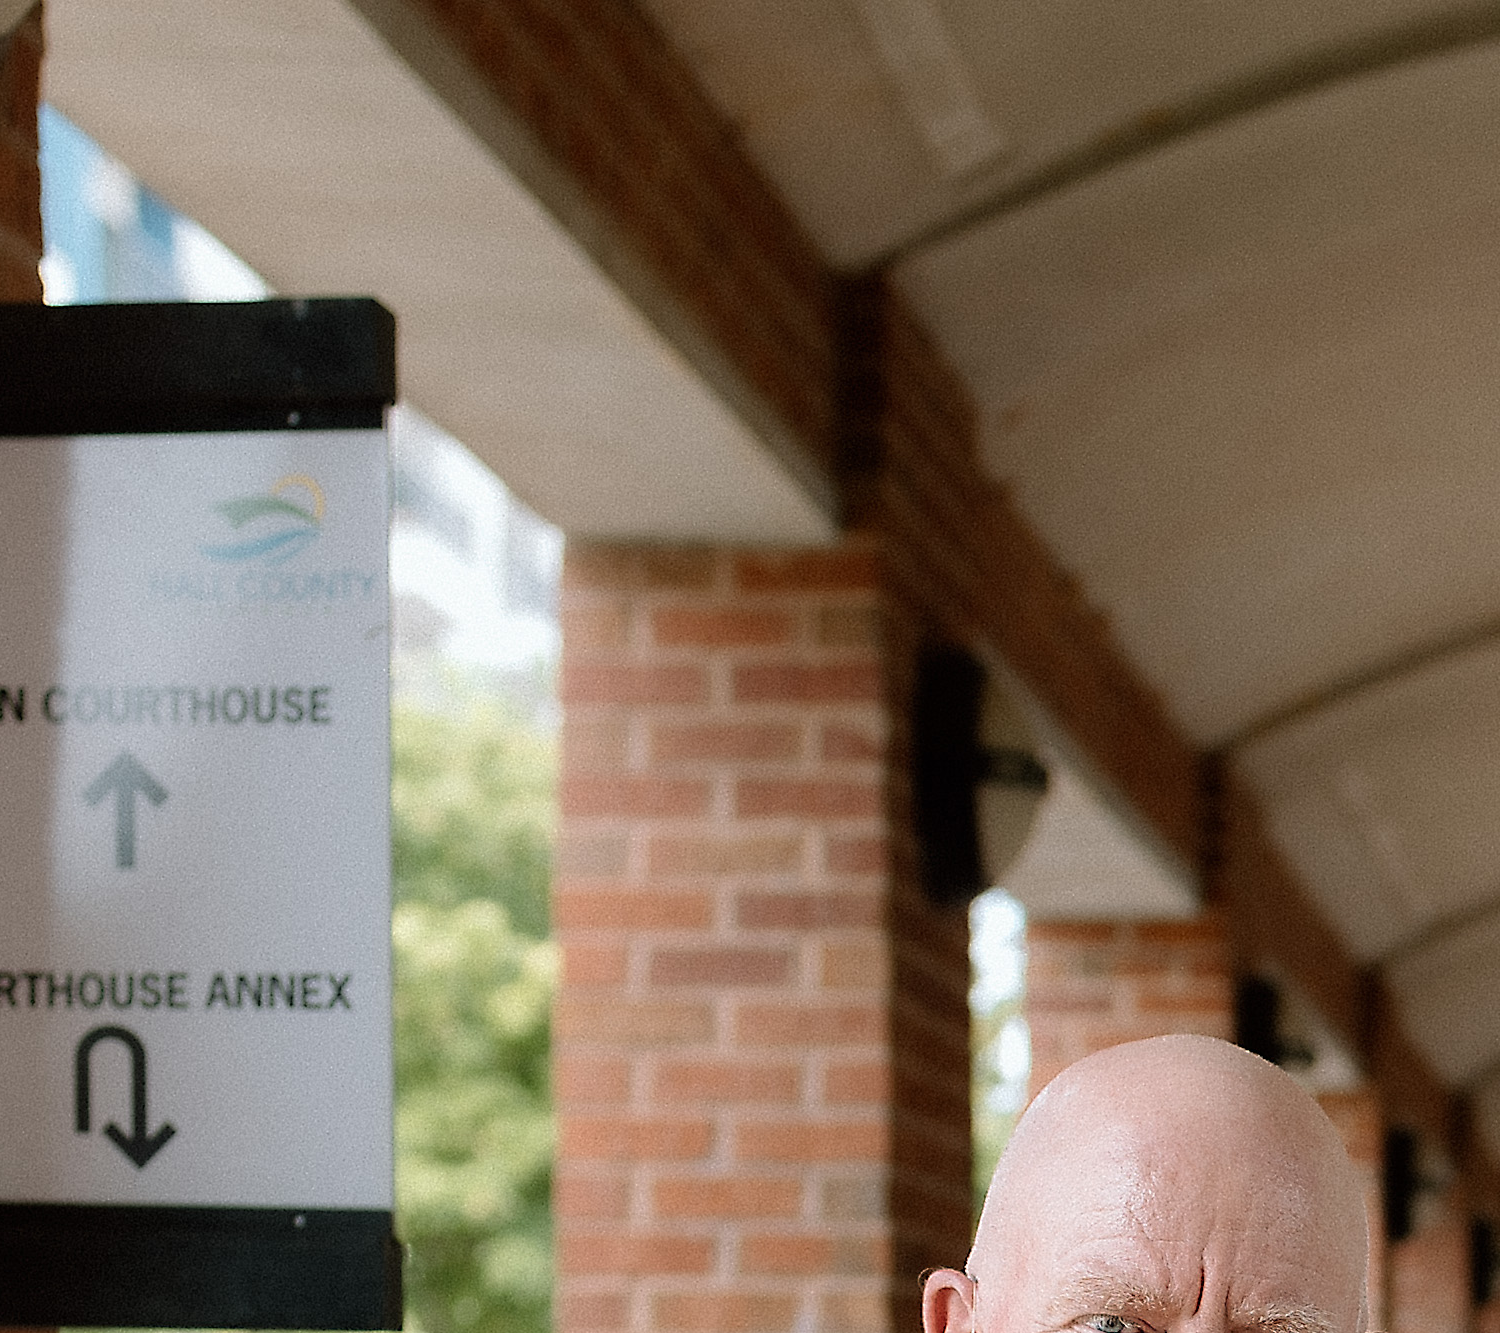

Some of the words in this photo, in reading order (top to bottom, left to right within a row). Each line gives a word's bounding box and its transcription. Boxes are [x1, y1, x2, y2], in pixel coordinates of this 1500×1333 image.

[236, 568, 377, 602] COUNTY
[42, 684, 333, 725] COURTHOUSE
[206, 970, 353, 1010] ANNEX
